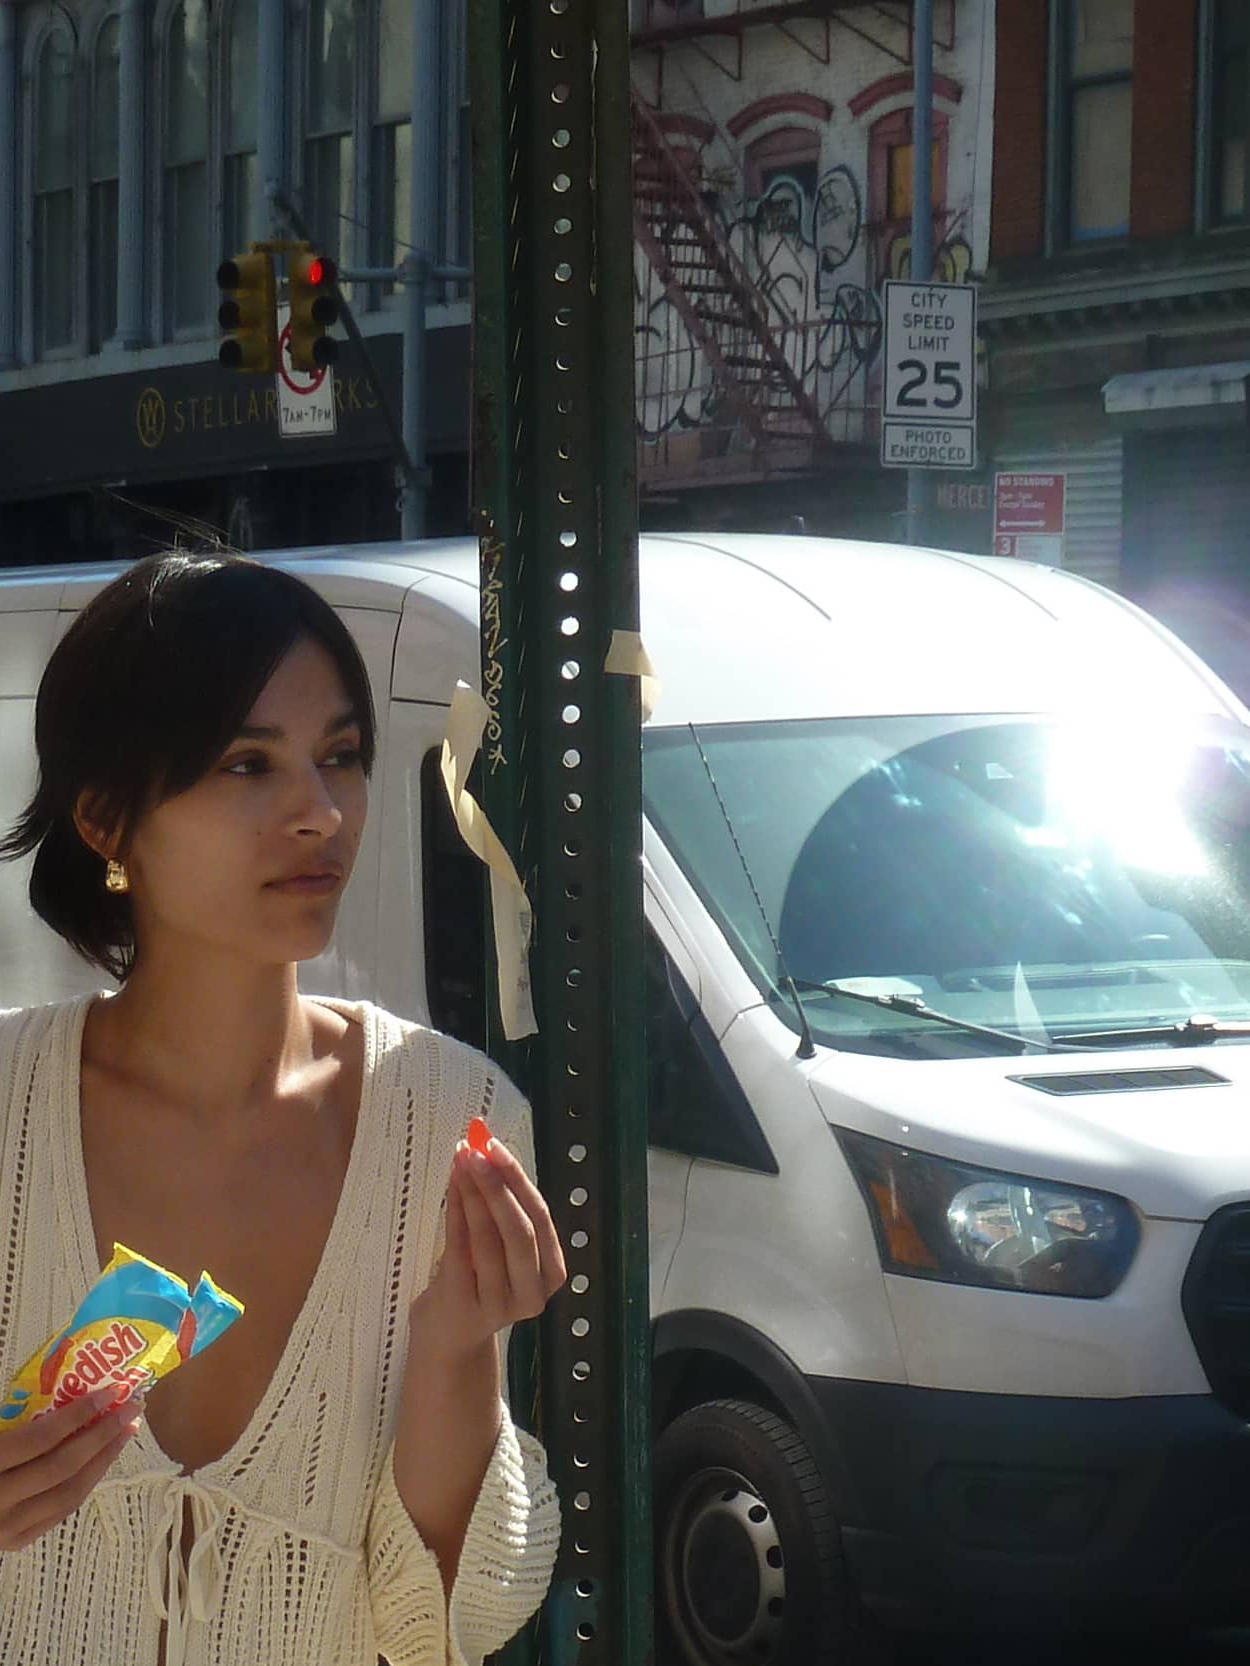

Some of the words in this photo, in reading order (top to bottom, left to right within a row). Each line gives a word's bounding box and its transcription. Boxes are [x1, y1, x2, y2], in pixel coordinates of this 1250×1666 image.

[911, 293, 948, 309] CITY
[902, 313, 955, 331] SPEED
[908, 335, 950, 352] LIMIT
[896, 358, 964, 409] 25
[172, 388, 278, 433] STELLAR
[334, 377, 379, 413] RKS
[283, 405, 331, 424] 7AM-7PM
[905, 429, 952, 444] PHOTO
[890, 444, 966, 461] ENFORCED
